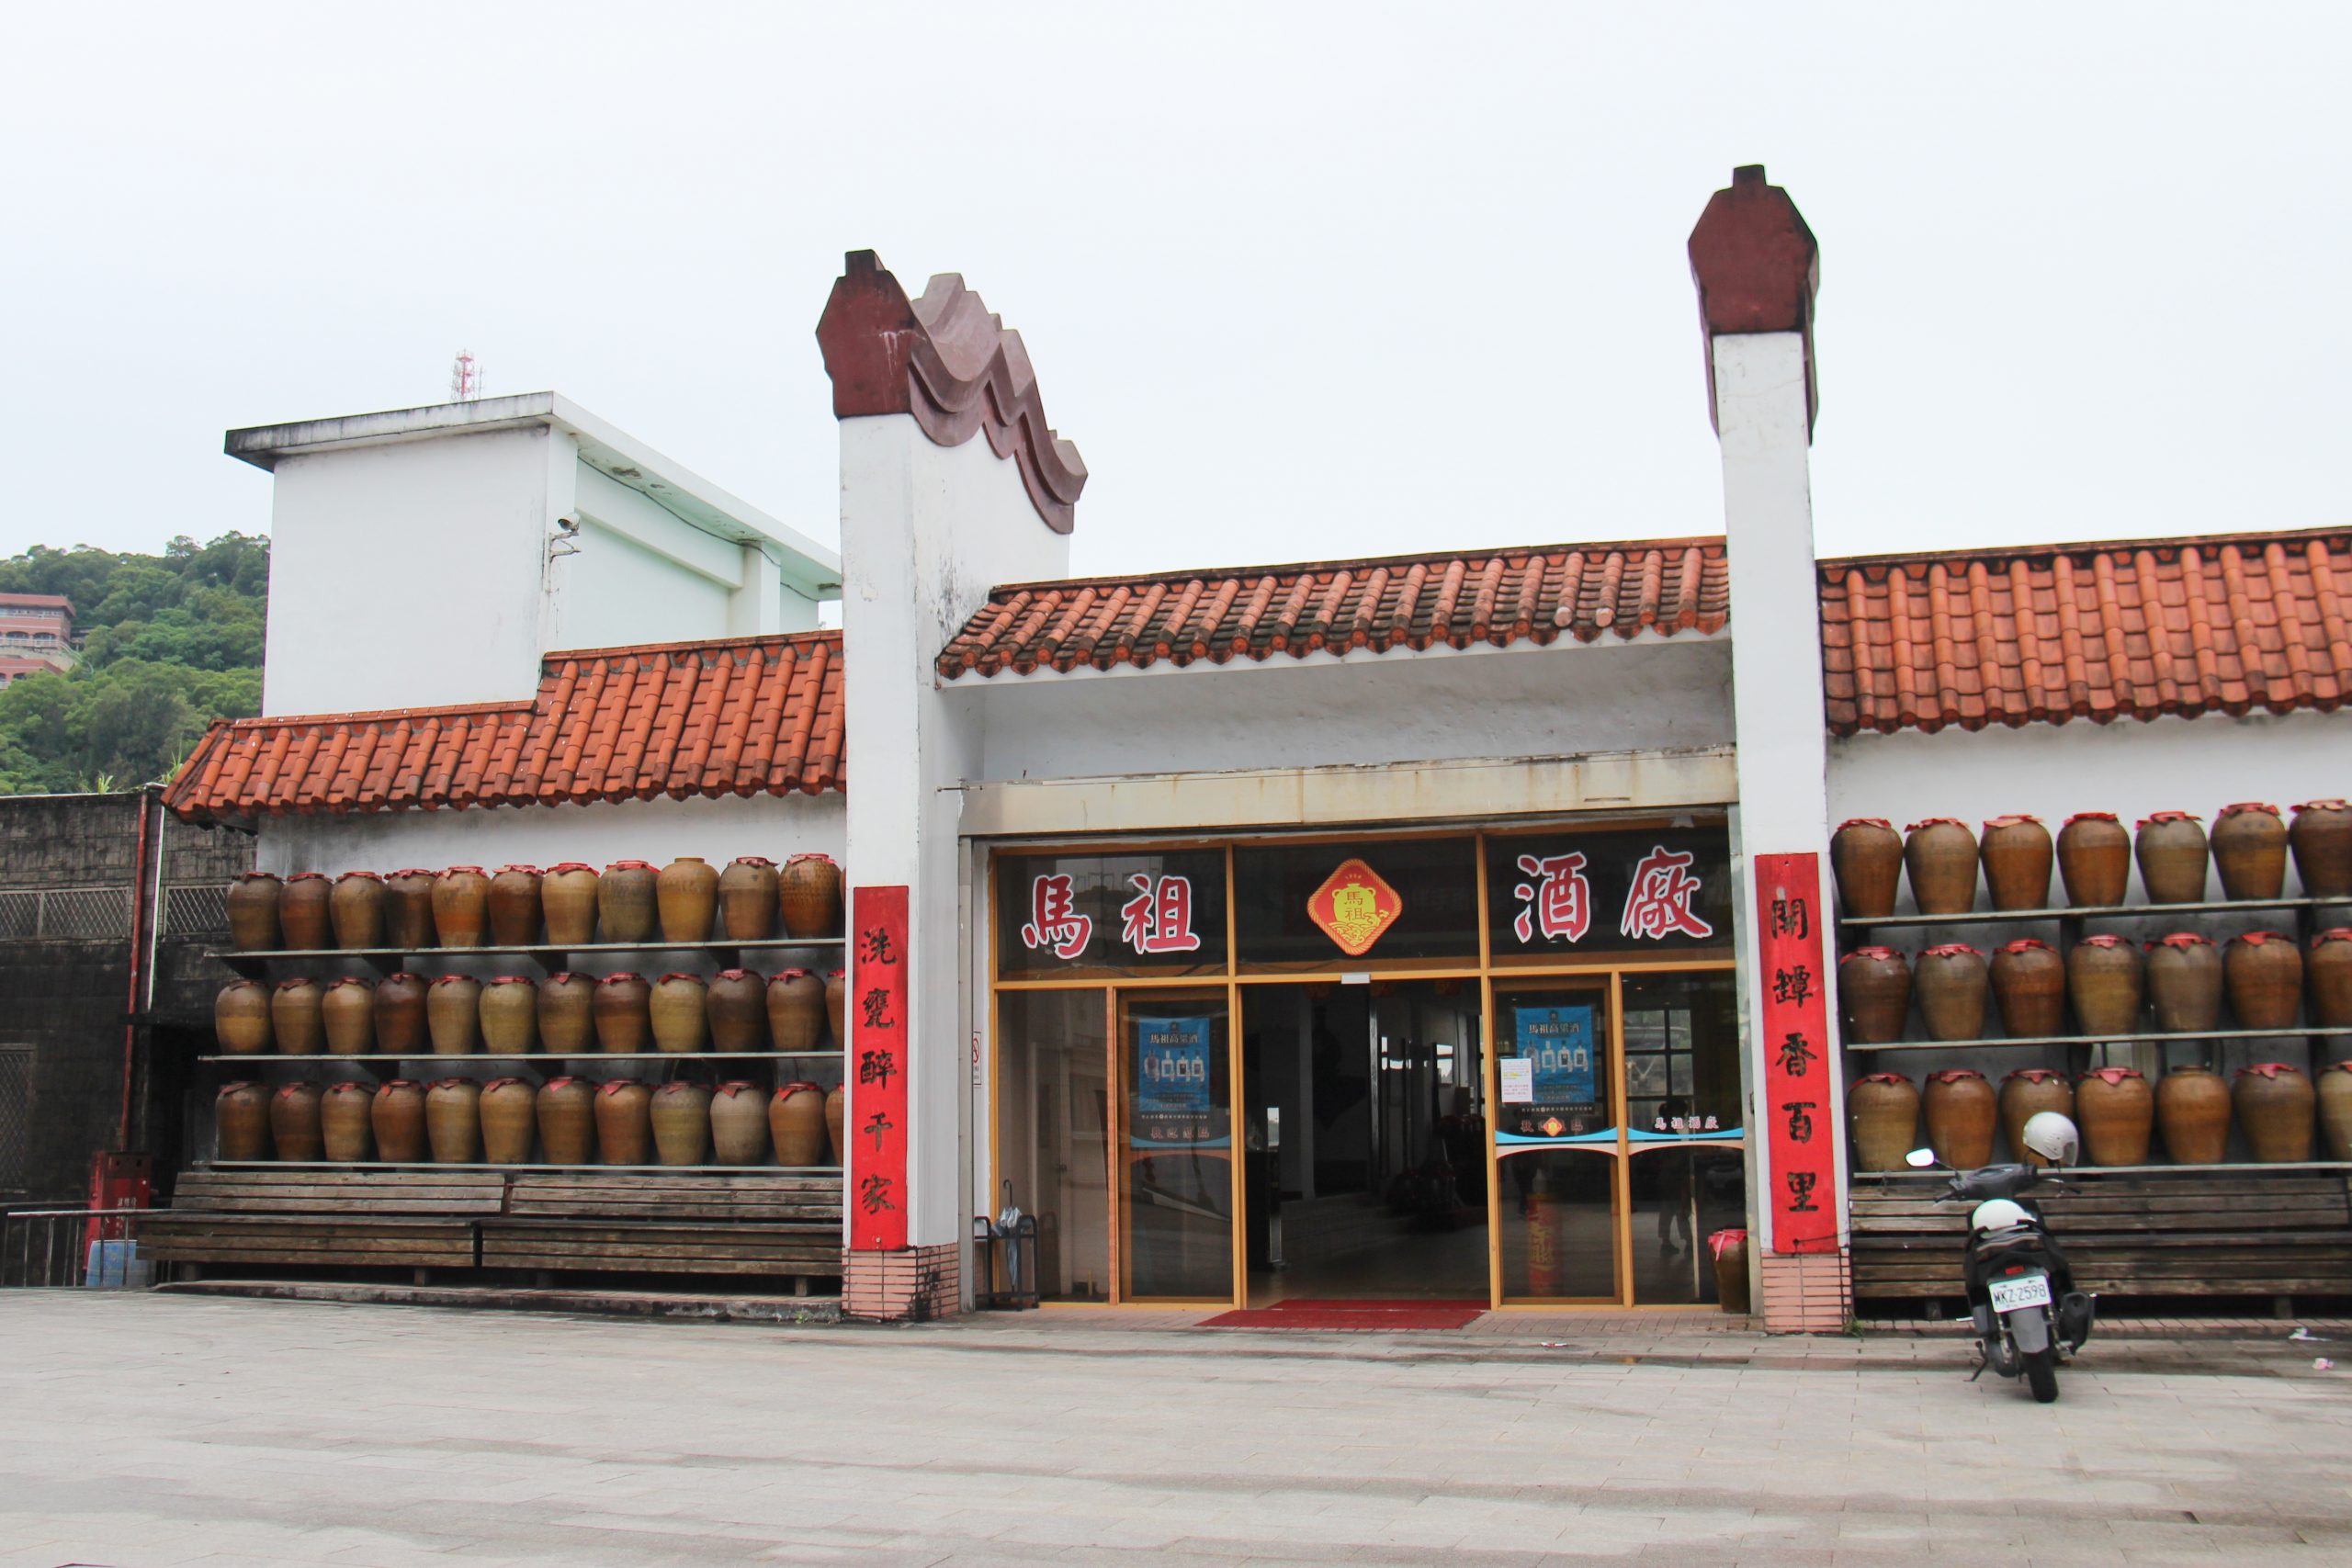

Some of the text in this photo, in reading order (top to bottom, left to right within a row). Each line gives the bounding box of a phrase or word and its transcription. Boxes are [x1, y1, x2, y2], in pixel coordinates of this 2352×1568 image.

[1022, 845, 1713, 959] 馬祖 酒廠
[1344, 891, 1365, 921] 馬祖
